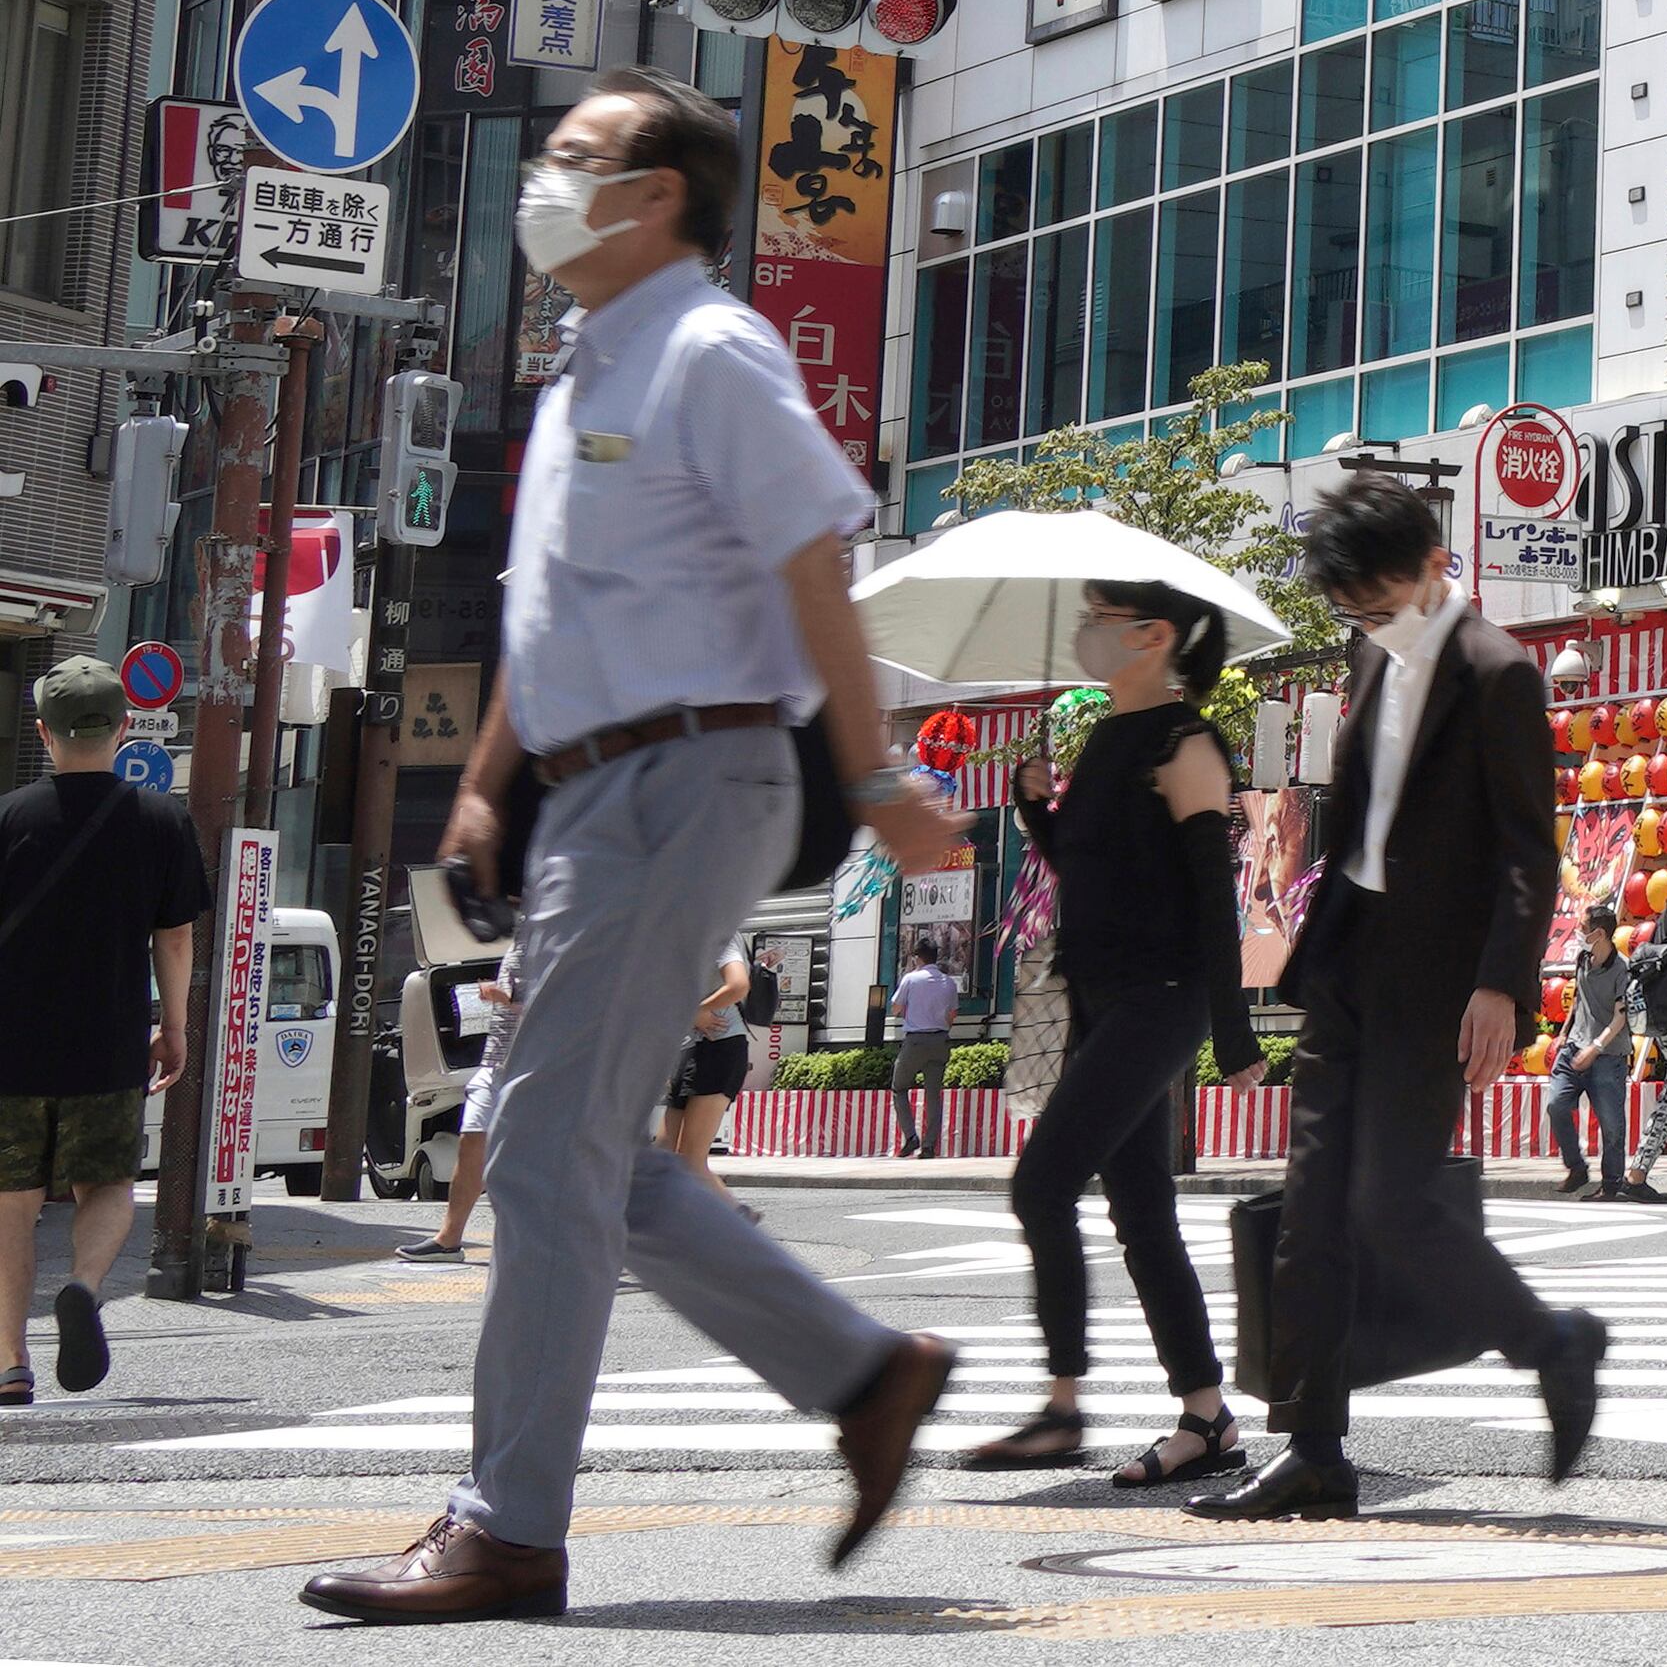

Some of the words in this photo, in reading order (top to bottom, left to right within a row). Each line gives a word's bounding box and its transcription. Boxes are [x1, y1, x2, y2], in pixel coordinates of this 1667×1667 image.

[254, 181, 379, 222] 自転車を除く
[254, 219, 376, 253] 一方通行
[754, 264, 794, 287] 6F
[788, 305, 872, 427] 白木
[1501, 445, 1560, 483] 消火栓
[1485, 521, 1578, 543] レインボー
[1518, 545, 1577, 566] ホテル
[350, 866, 385, 1037] YANAGI-DORI
